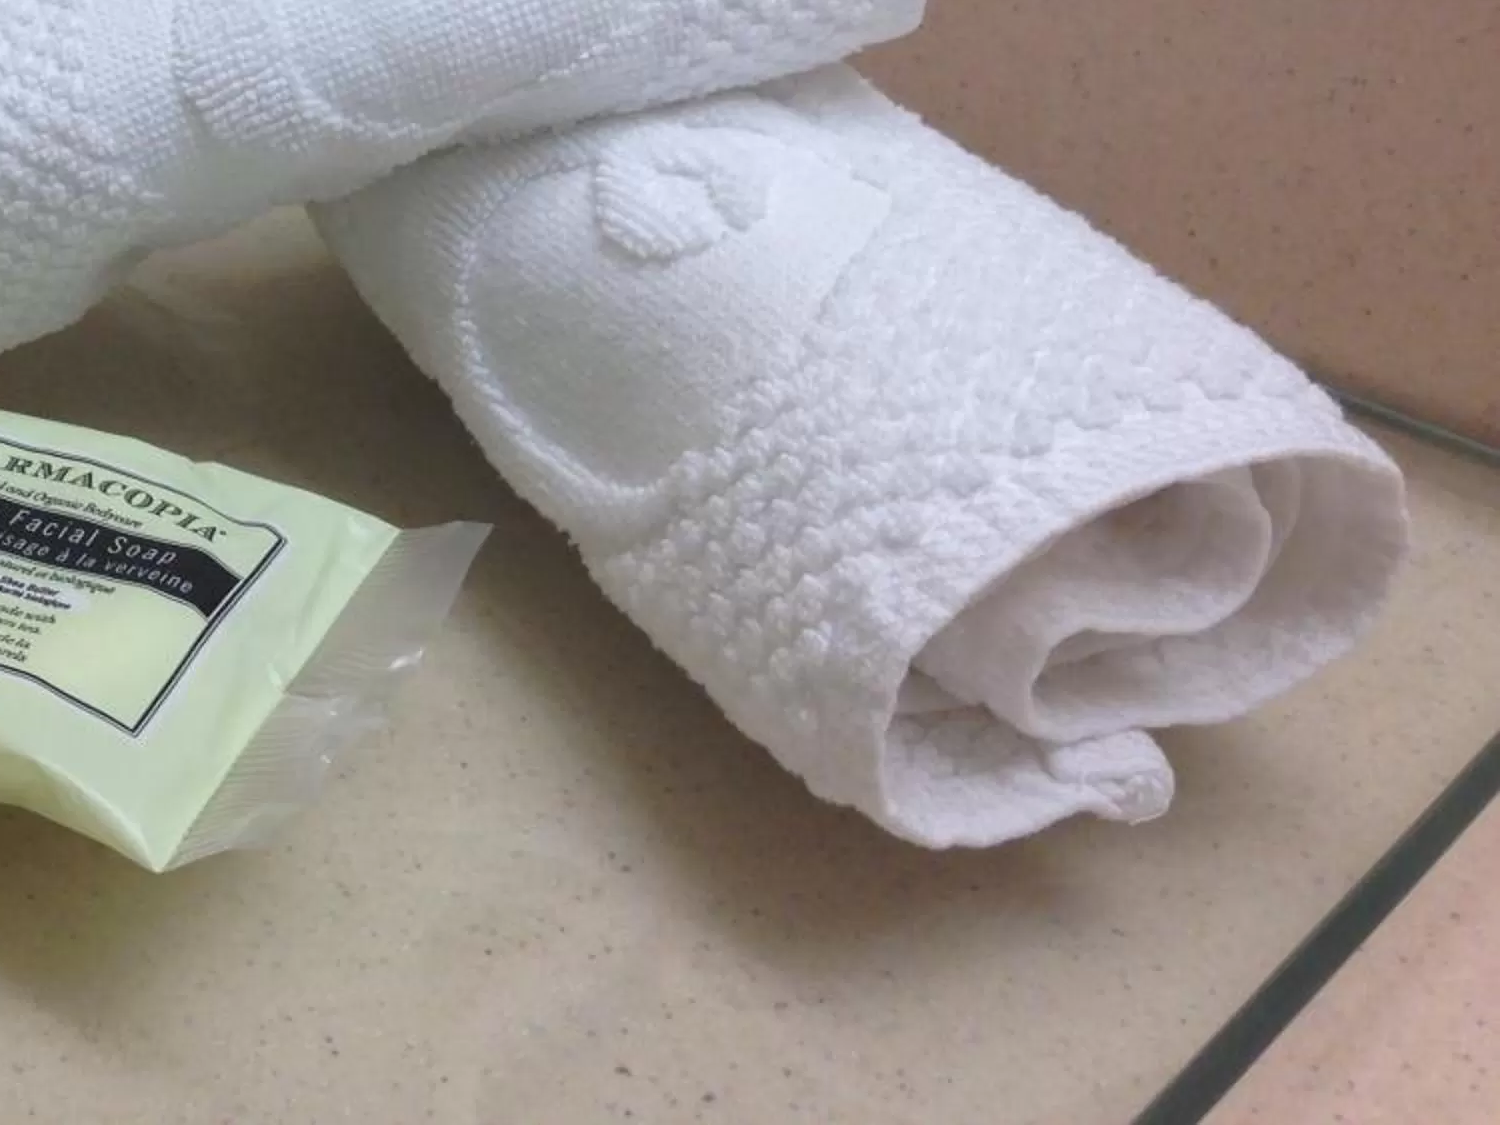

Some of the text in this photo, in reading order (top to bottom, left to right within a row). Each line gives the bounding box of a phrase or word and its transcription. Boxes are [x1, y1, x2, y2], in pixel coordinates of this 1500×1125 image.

[8, 508, 100, 547] Facial
[106, 535, 178, 566] Soap
[75, 552, 97, 569] la
[104, 558, 194, 594] verveine
